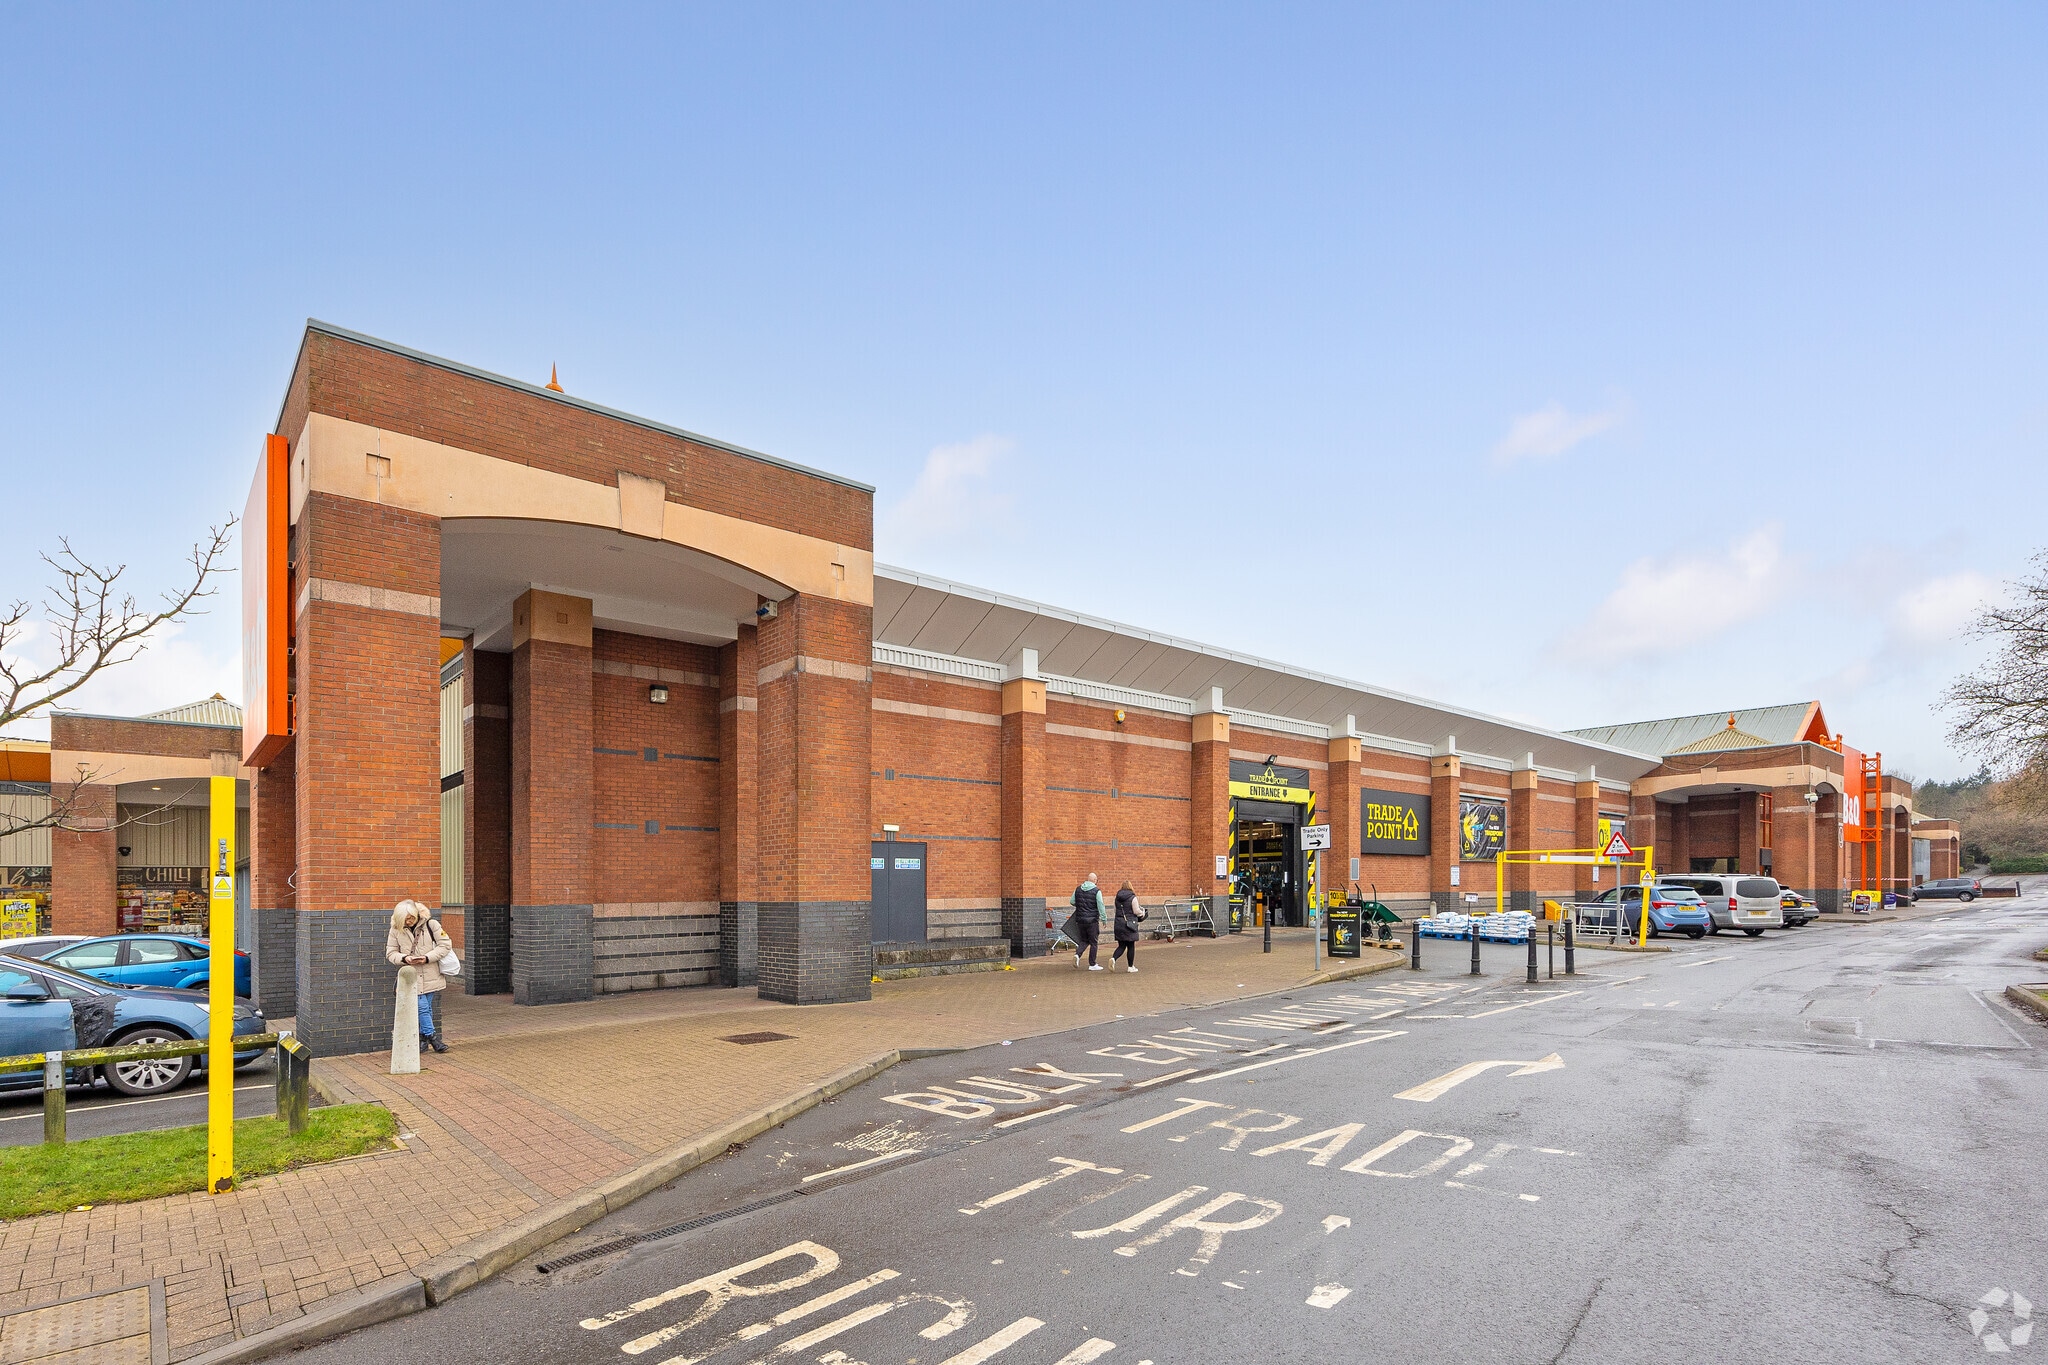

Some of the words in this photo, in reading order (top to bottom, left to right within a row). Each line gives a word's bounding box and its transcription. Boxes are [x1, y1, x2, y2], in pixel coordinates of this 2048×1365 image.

[1249, 774, 1265, 782] TRADE
[1250, 785, 1280, 798] ENTRANCE
[1367, 803, 1403, 822] TRADE
[1843, 792, 1860, 826] B&Q
[1366, 822, 1402, 839] POINT
[880, 1062, 1124, 1120] BULK
[1086, 1026, 1257, 1065] EXIT
[1213, 995, 1407, 1031] WAITING
